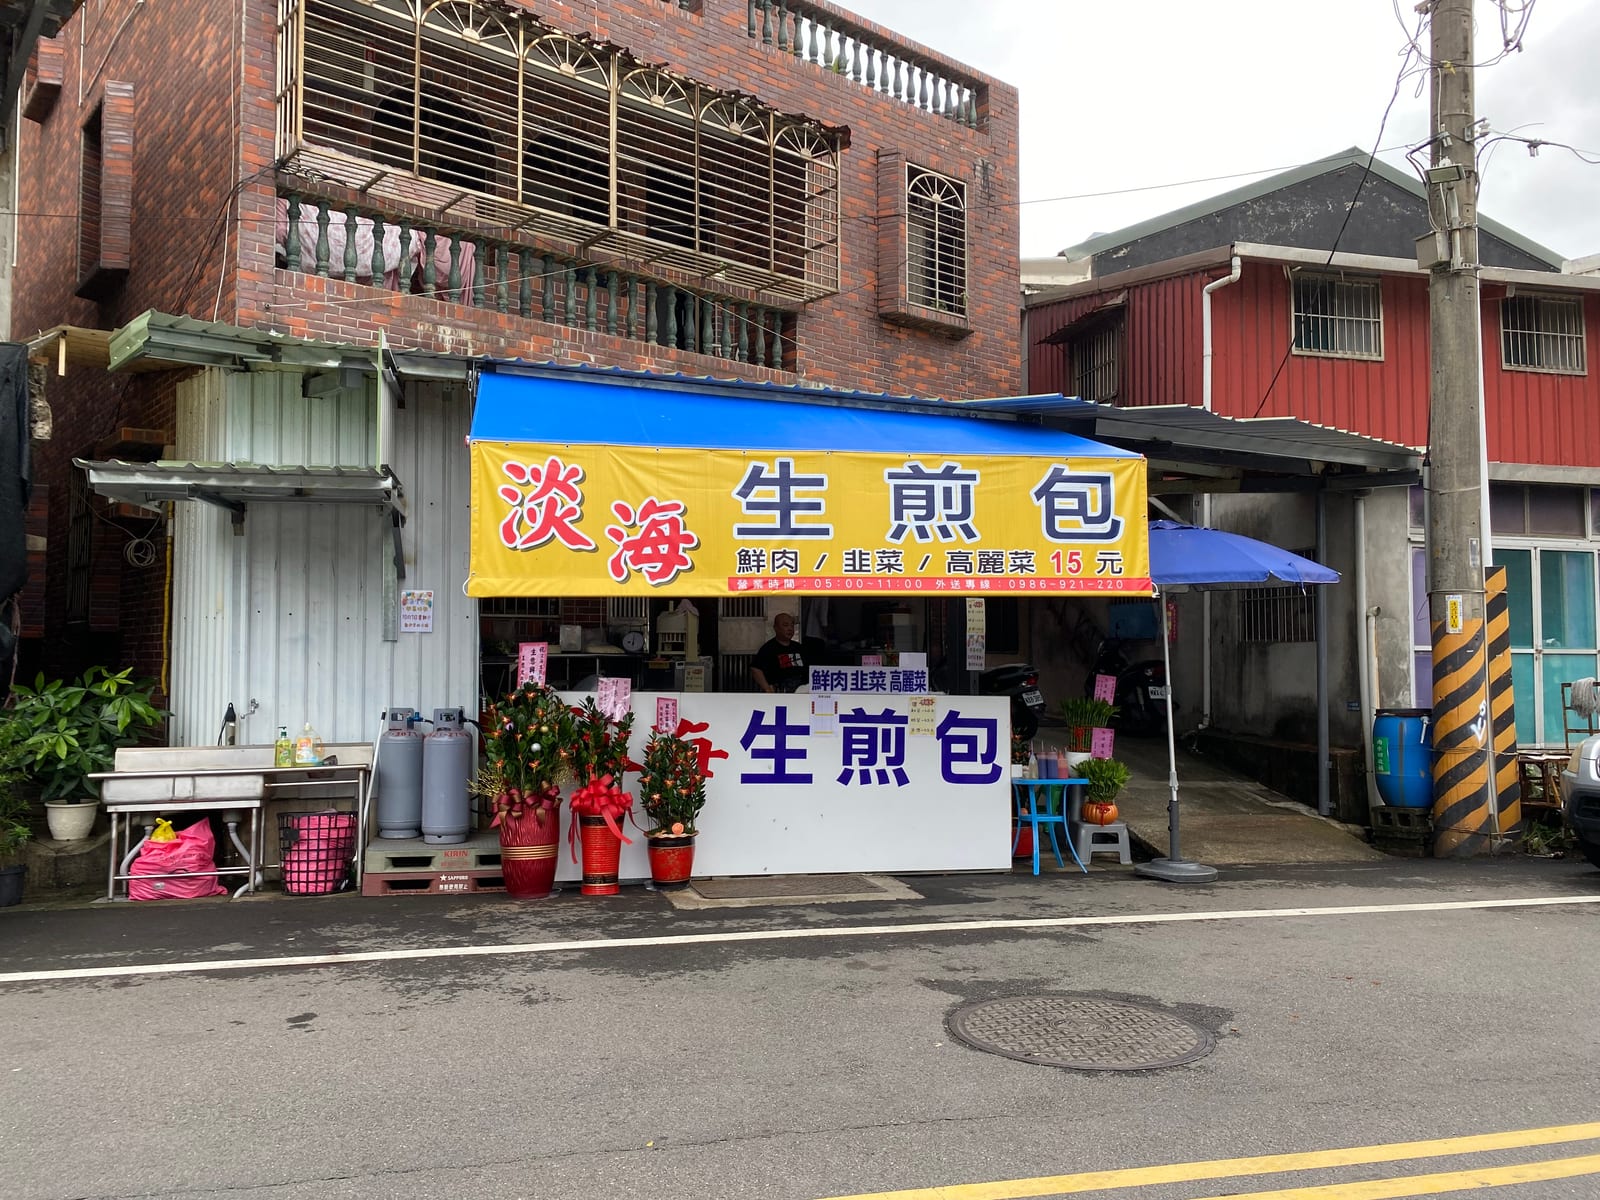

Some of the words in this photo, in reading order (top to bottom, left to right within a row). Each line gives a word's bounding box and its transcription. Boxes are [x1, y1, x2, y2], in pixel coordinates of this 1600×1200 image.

[499, 457, 699, 583] 淡海
[734, 459, 1123, 542] 生煎包
[737, 548, 799, 574] 鮮肉
[843, 549, 903, 574] 韭菜
[946, 550, 1035, 574] 高麗菜
[1050, 550, 1082, 574] 15
[1096, 551, 1123, 574] 元
[811, 670, 848, 692] 鮮肉
[850, 670, 887, 692] 韭菜
[889, 670, 927, 693] 高麗菜
[741, 706, 1002, 787] 生煎包
